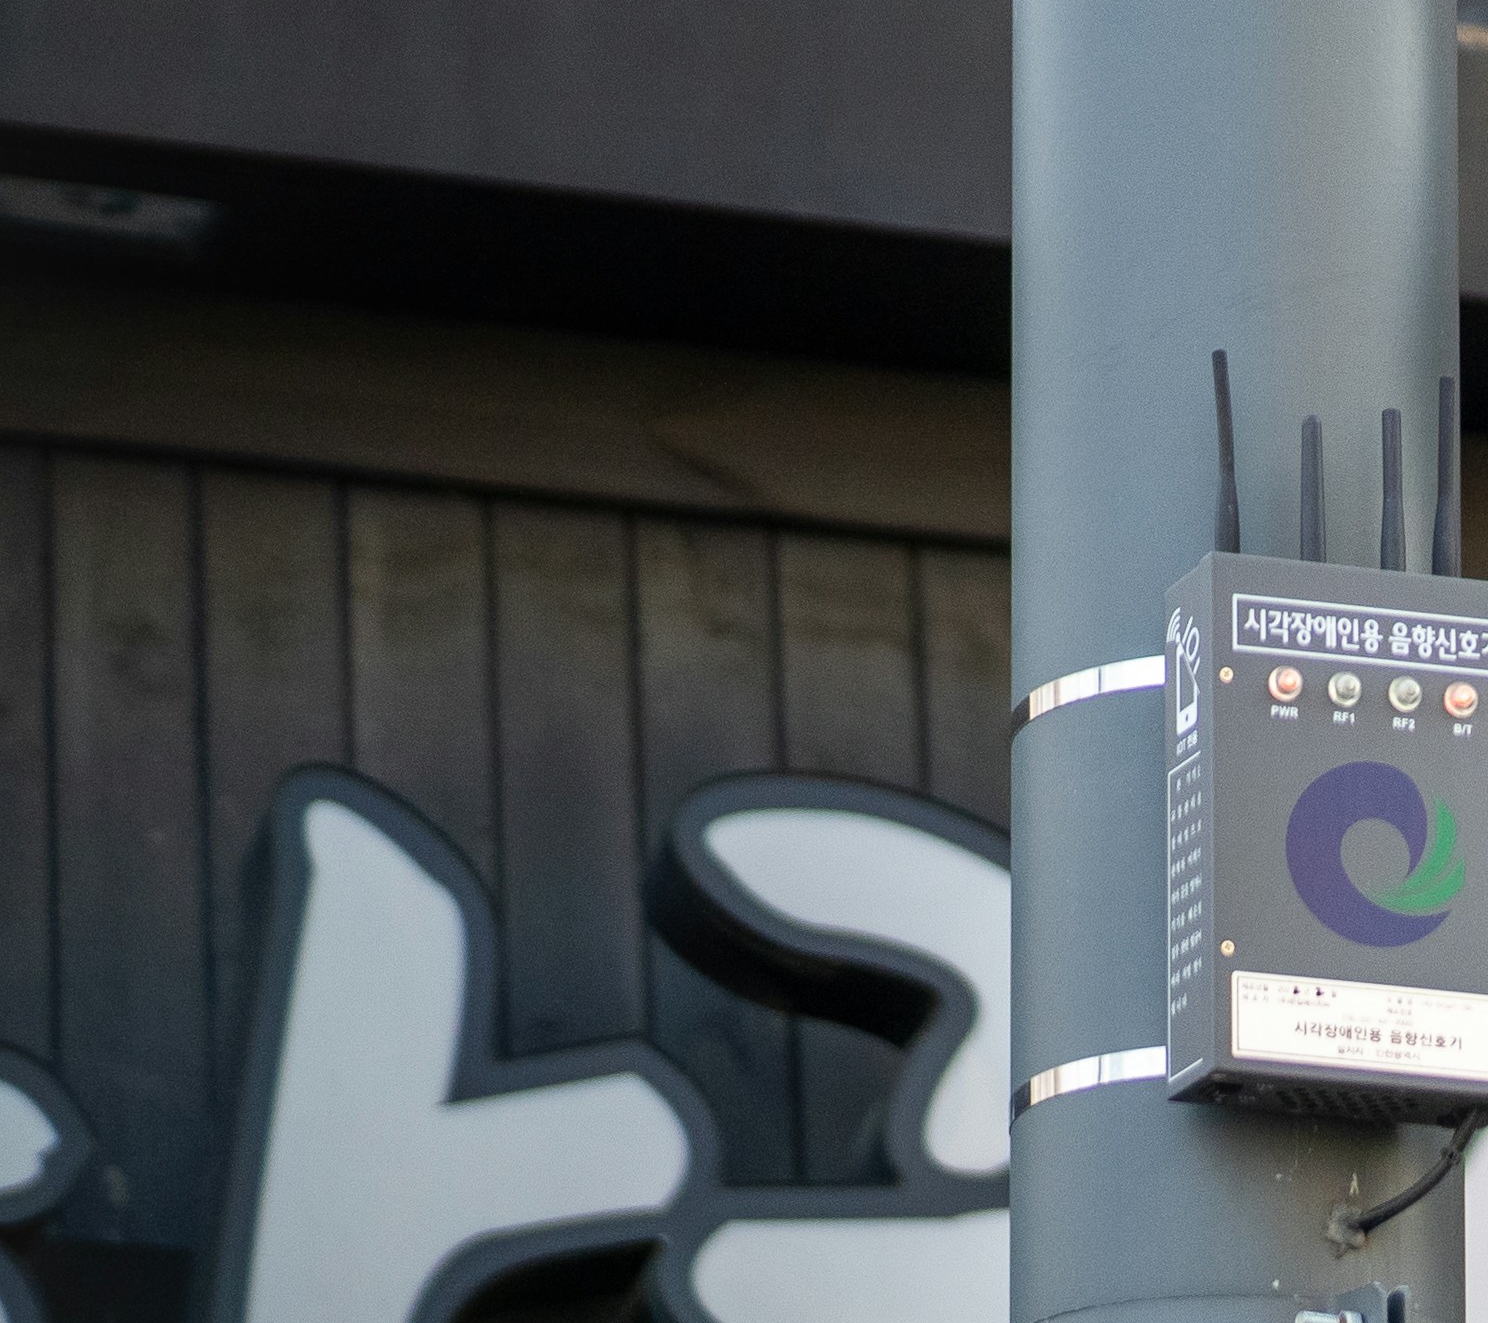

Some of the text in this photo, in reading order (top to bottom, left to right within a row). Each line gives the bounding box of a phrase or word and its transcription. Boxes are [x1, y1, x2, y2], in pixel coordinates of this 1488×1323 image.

[1244, 607, 1383, 654] 시각장애인용
[1270, 705, 1299, 719] PWR
[1333, 711, 1355, 724] RF1
[1393, 717, 1416, 730] RF2
[1453, 723, 1473, 735] B/T
[1295, 1020, 1463, 1051] 시각장애인용 음향신호기
